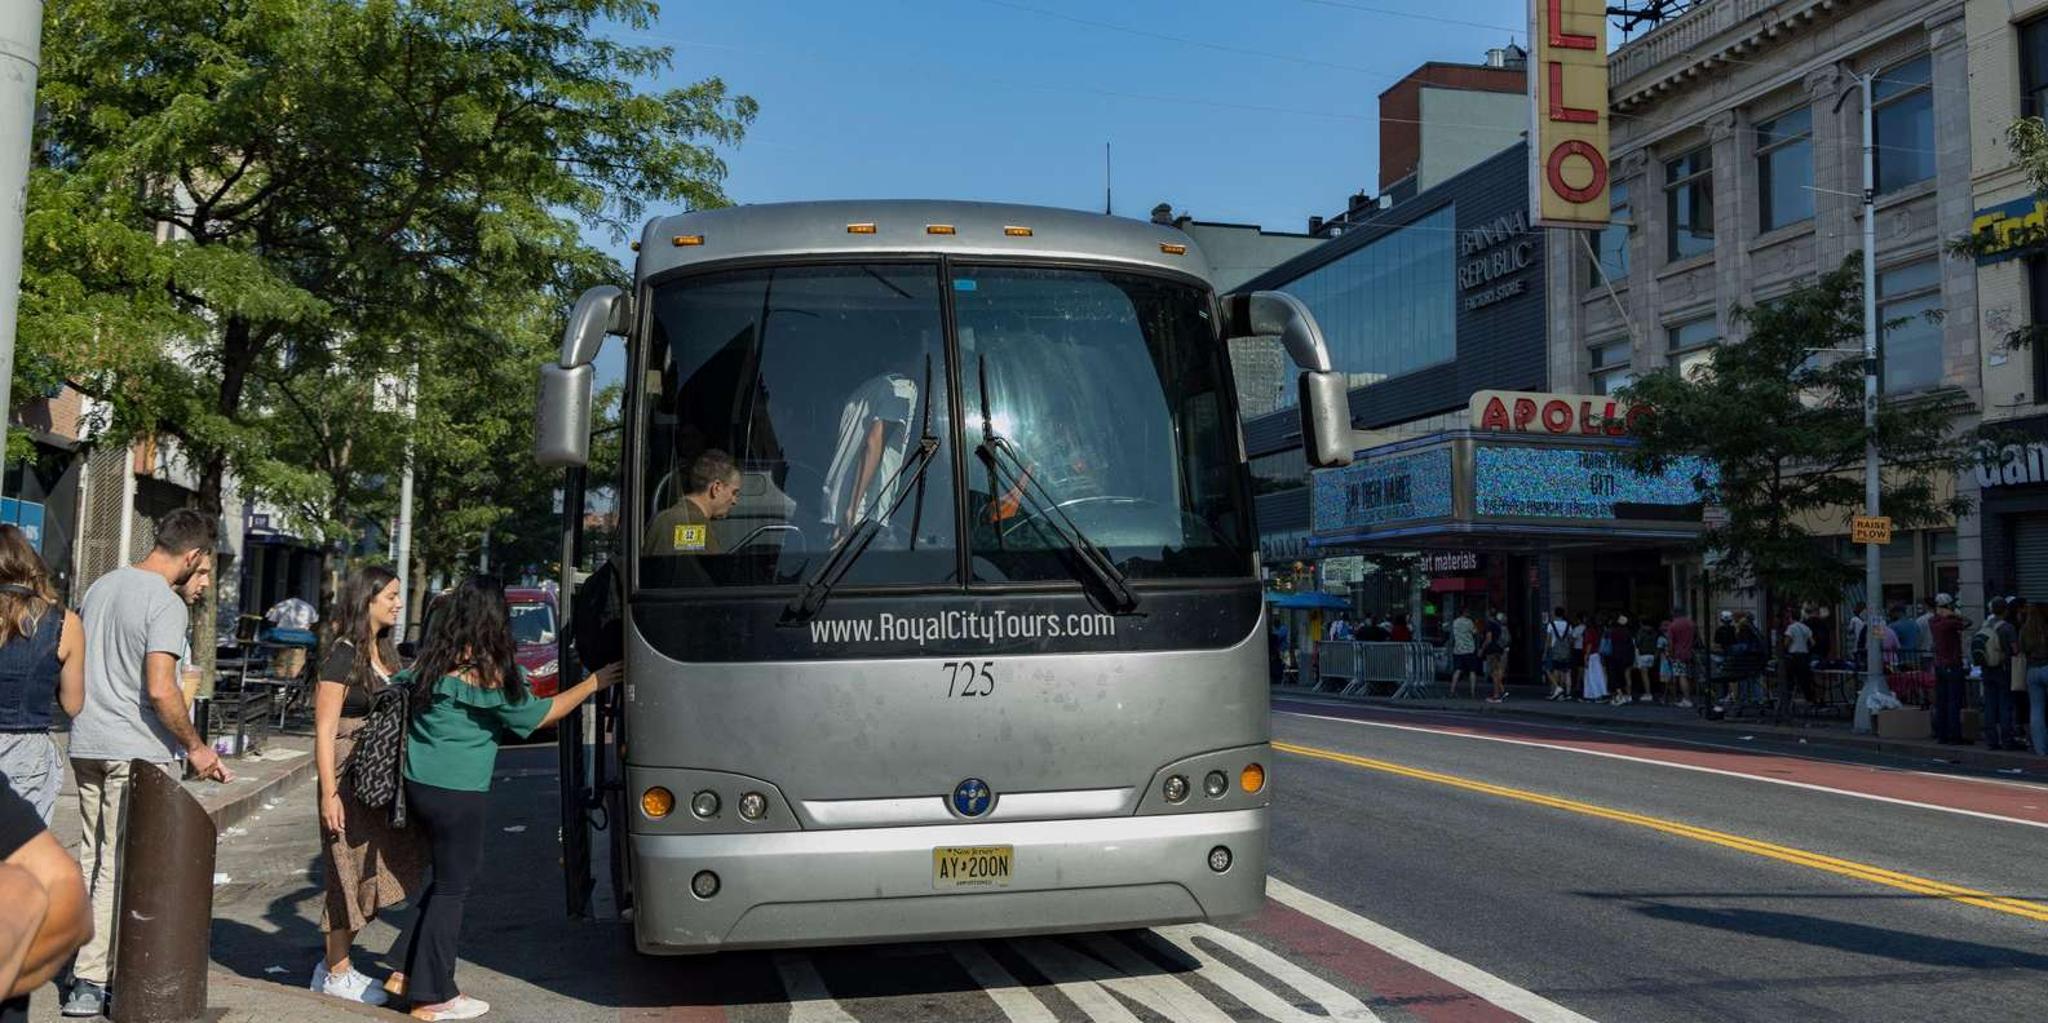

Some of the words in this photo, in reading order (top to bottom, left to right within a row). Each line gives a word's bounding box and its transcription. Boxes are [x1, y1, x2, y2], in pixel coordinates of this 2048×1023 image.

[1462, 208, 1529, 256] BANANA
[1458, 241, 1534, 291] REPUBLIC
[1496, 279, 1527, 303] STORE
[1857, 520, 1886, 529] RAISE
[1857, 529, 1887, 538] PLOW
[1435, 551, 1477, 572] materials
[810, 610, 1116, 646] www.RoyalCityTours.com
[942, 661, 995, 698] 725
